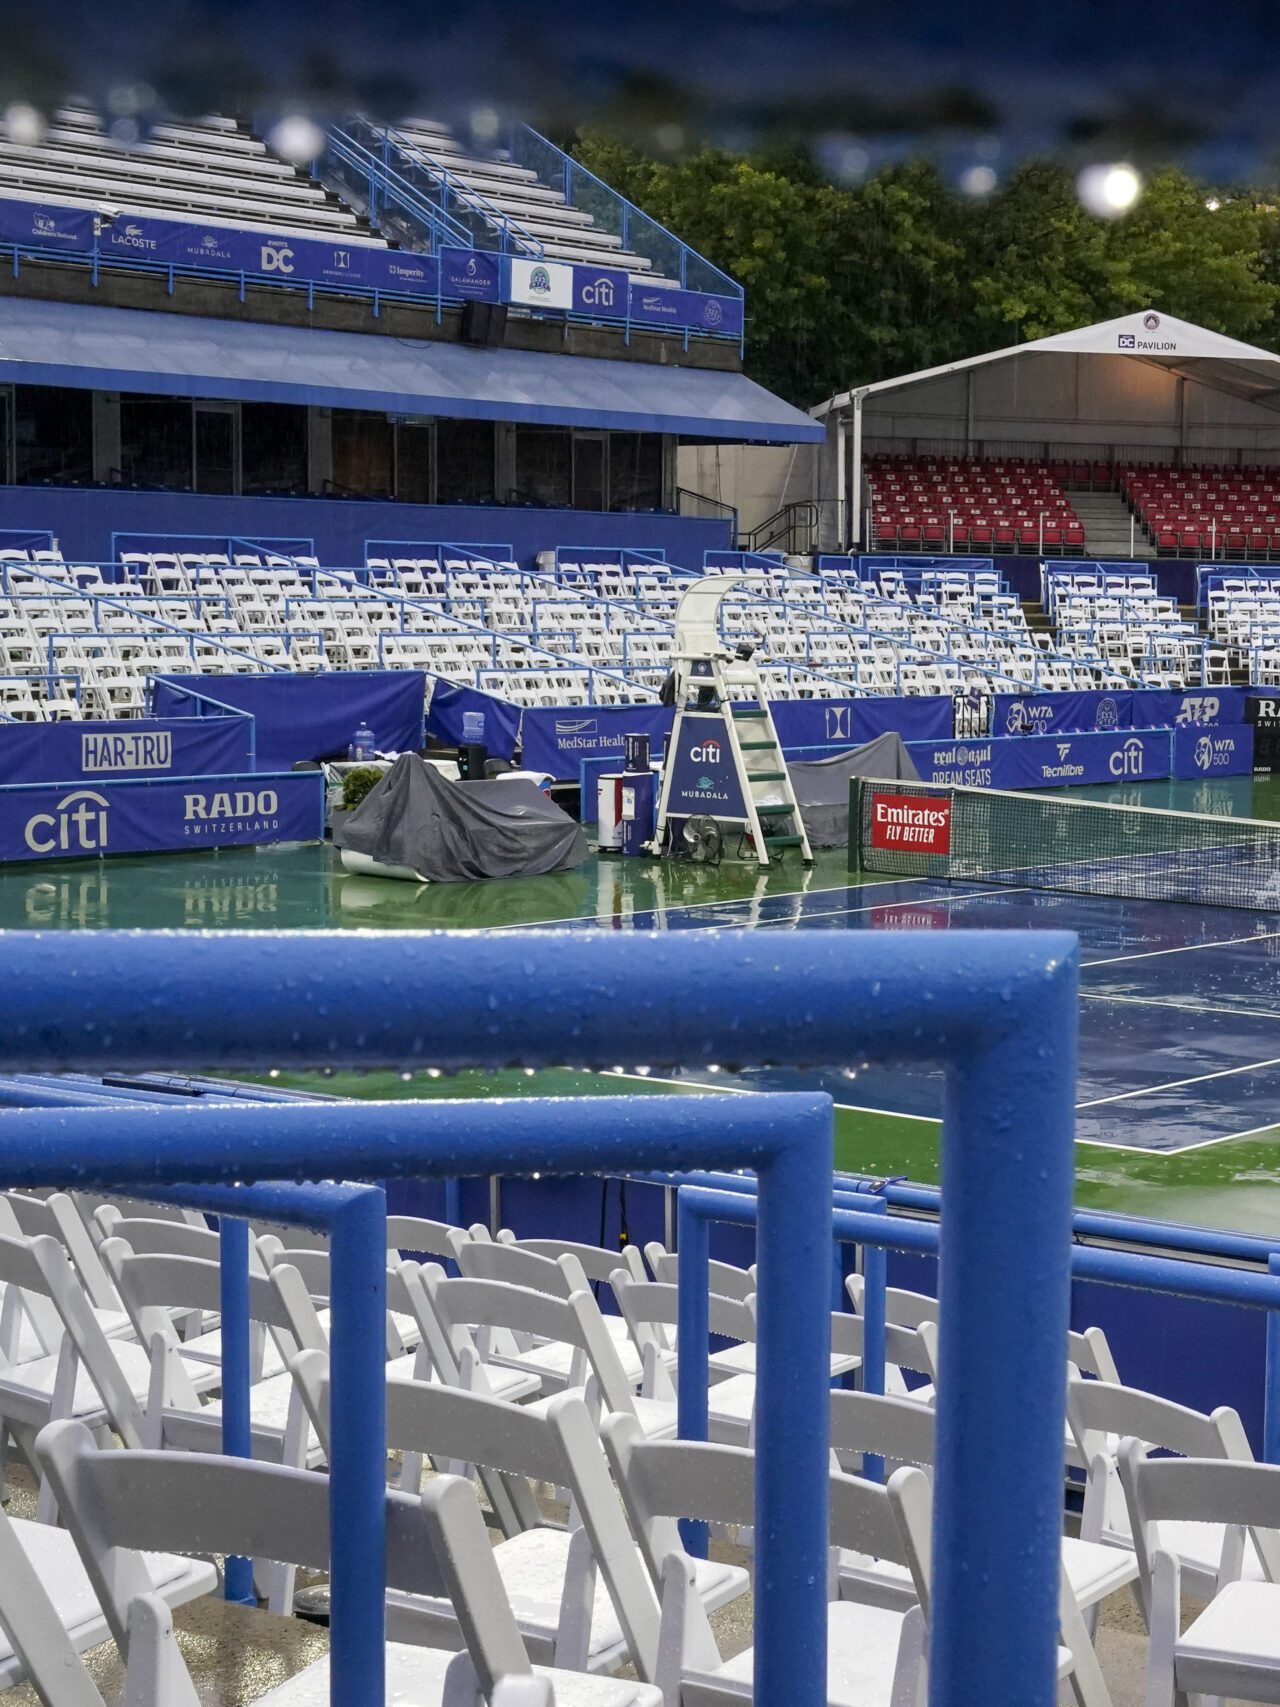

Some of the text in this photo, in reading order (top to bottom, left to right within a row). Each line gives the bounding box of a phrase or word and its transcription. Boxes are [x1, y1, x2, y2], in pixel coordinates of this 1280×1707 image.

[111, 234, 157, 250] LACOSTE
[187, 247, 231, 258] MUBADALA
[261, 246, 295, 273] DC
[397, 267, 425, 279] Insperity
[451, 276, 491, 286] SALAMANDER
[582, 278, 614, 306] citi
[1138, 341, 1176, 350] PAVILION
[1029, 706, 1053, 718] WTA
[1175, 696, 1220, 723] ATP
[558, 733, 625, 749] MedStar Healt
[1214, 739, 1235, 752] WTA
[84, 735, 169, 767] HAR-TRU
[690, 740, 720, 763] citi
[1109, 738, 1144, 775] citi
[1213, 752, 1229, 766] 500
[932, 768, 991, 786] DREAM SEATS
[1041, 764, 1084, 778] Tecnifibre
[682, 791, 728, 800] MUBADALA
[184, 790, 278, 820] RADO
[25, 790, 110, 852] citi
[184, 820, 279, 835] SWITZERLAND
[886, 824, 935, 844] FLY BETTER
